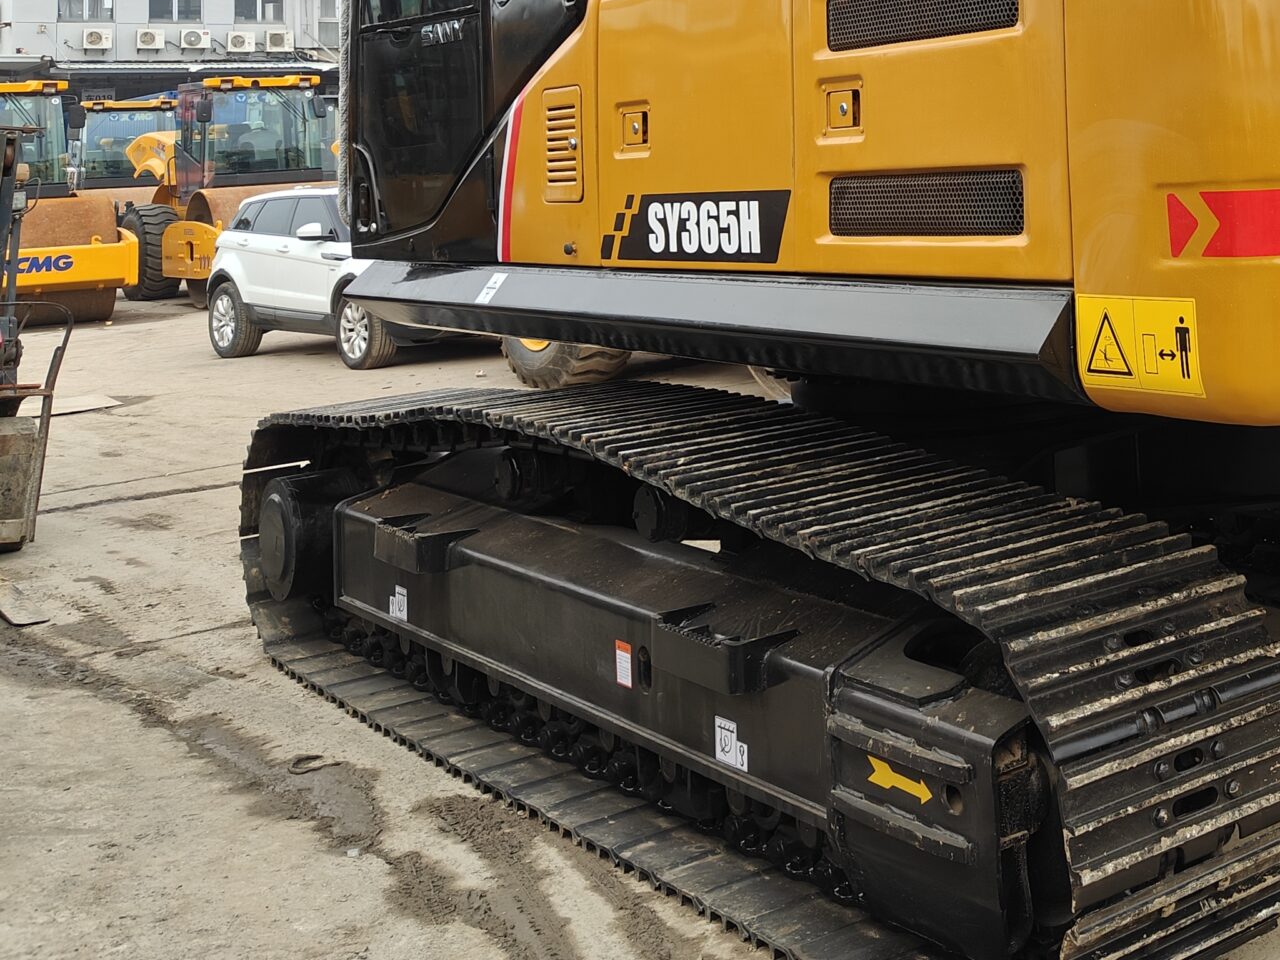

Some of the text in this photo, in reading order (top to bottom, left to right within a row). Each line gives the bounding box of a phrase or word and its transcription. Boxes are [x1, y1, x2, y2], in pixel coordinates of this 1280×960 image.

[421, 18, 465, 47] SANY
[647, 200, 761, 254] SY365H
[3, 254, 74, 275] CMG
